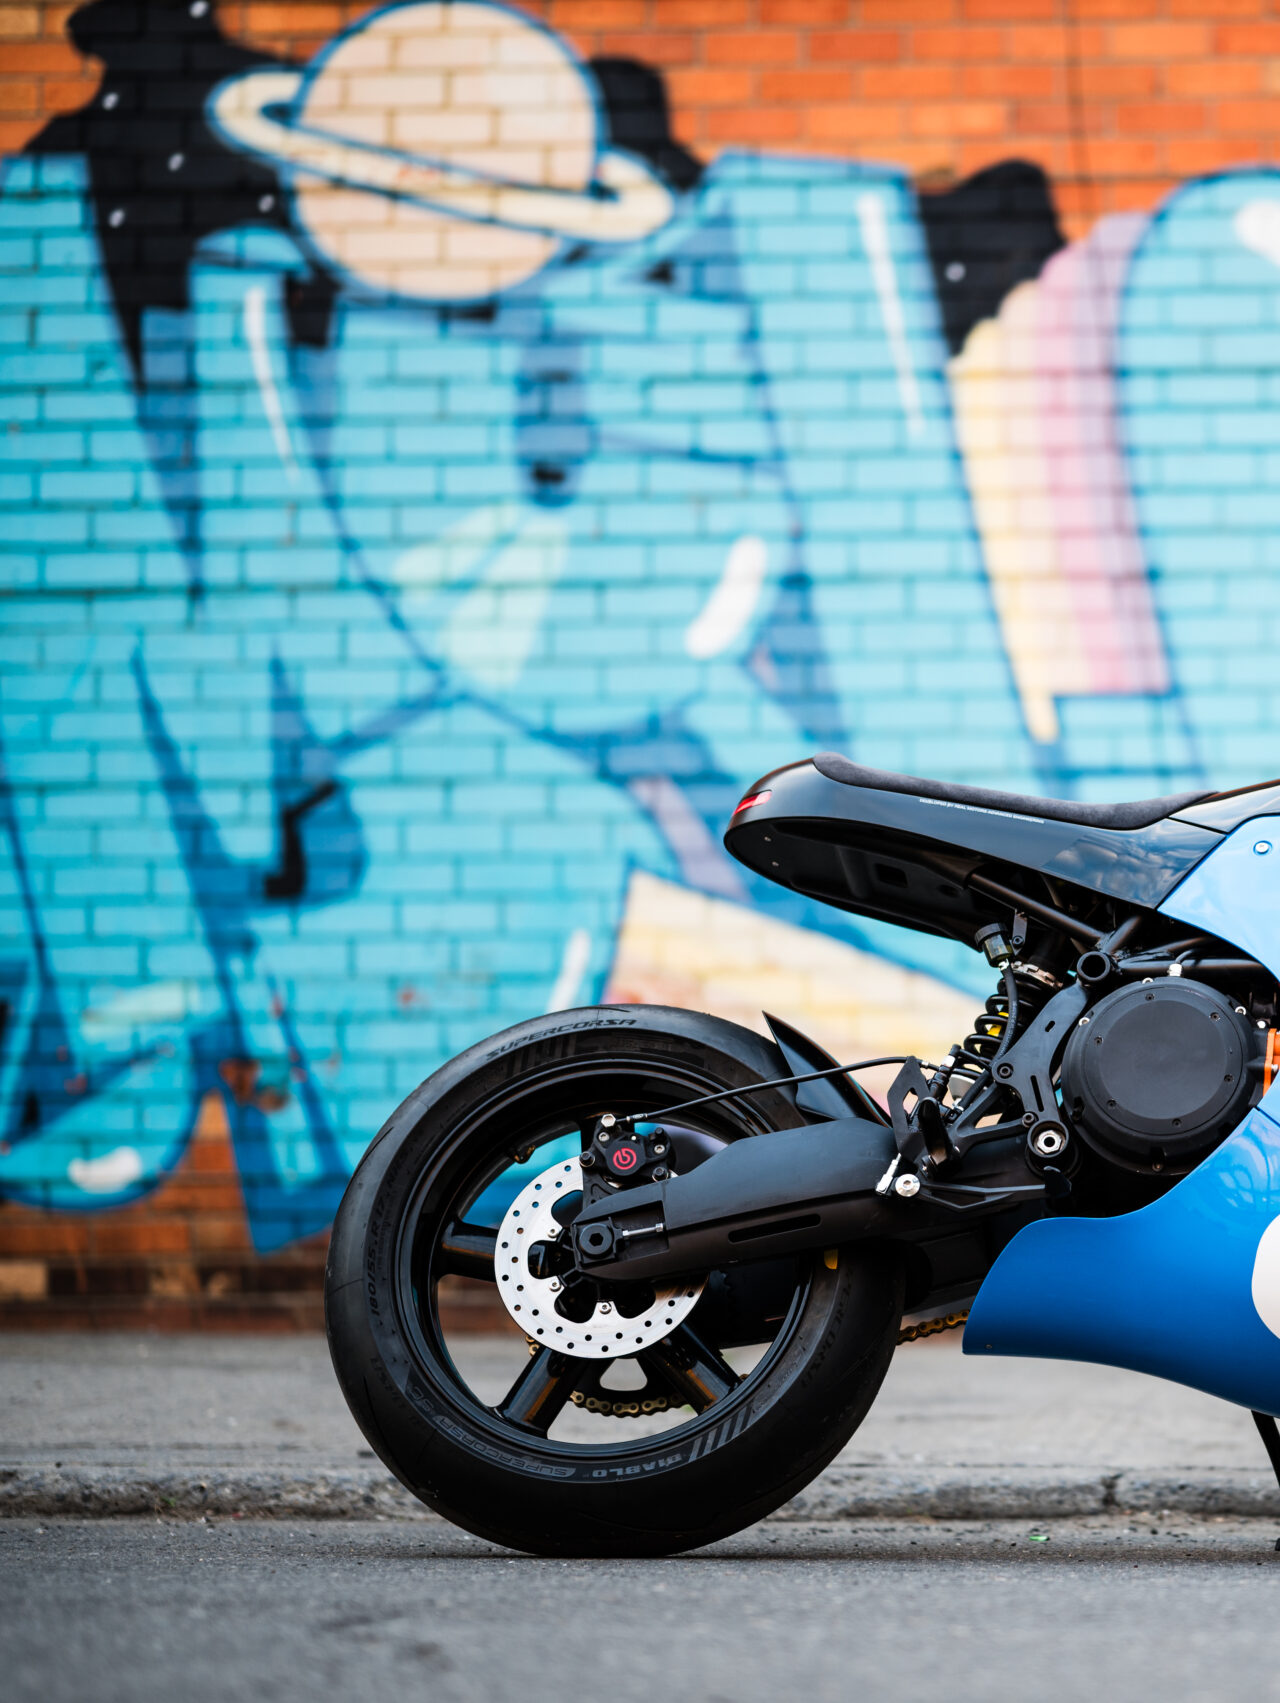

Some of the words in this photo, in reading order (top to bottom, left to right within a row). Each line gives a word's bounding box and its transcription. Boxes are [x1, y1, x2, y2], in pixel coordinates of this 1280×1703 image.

[485, 1018, 638, 1060] SUPERCORSA
[438, 1416, 570, 1478] SUPERCORSA
[592, 1452, 683, 1478] DIABLO
